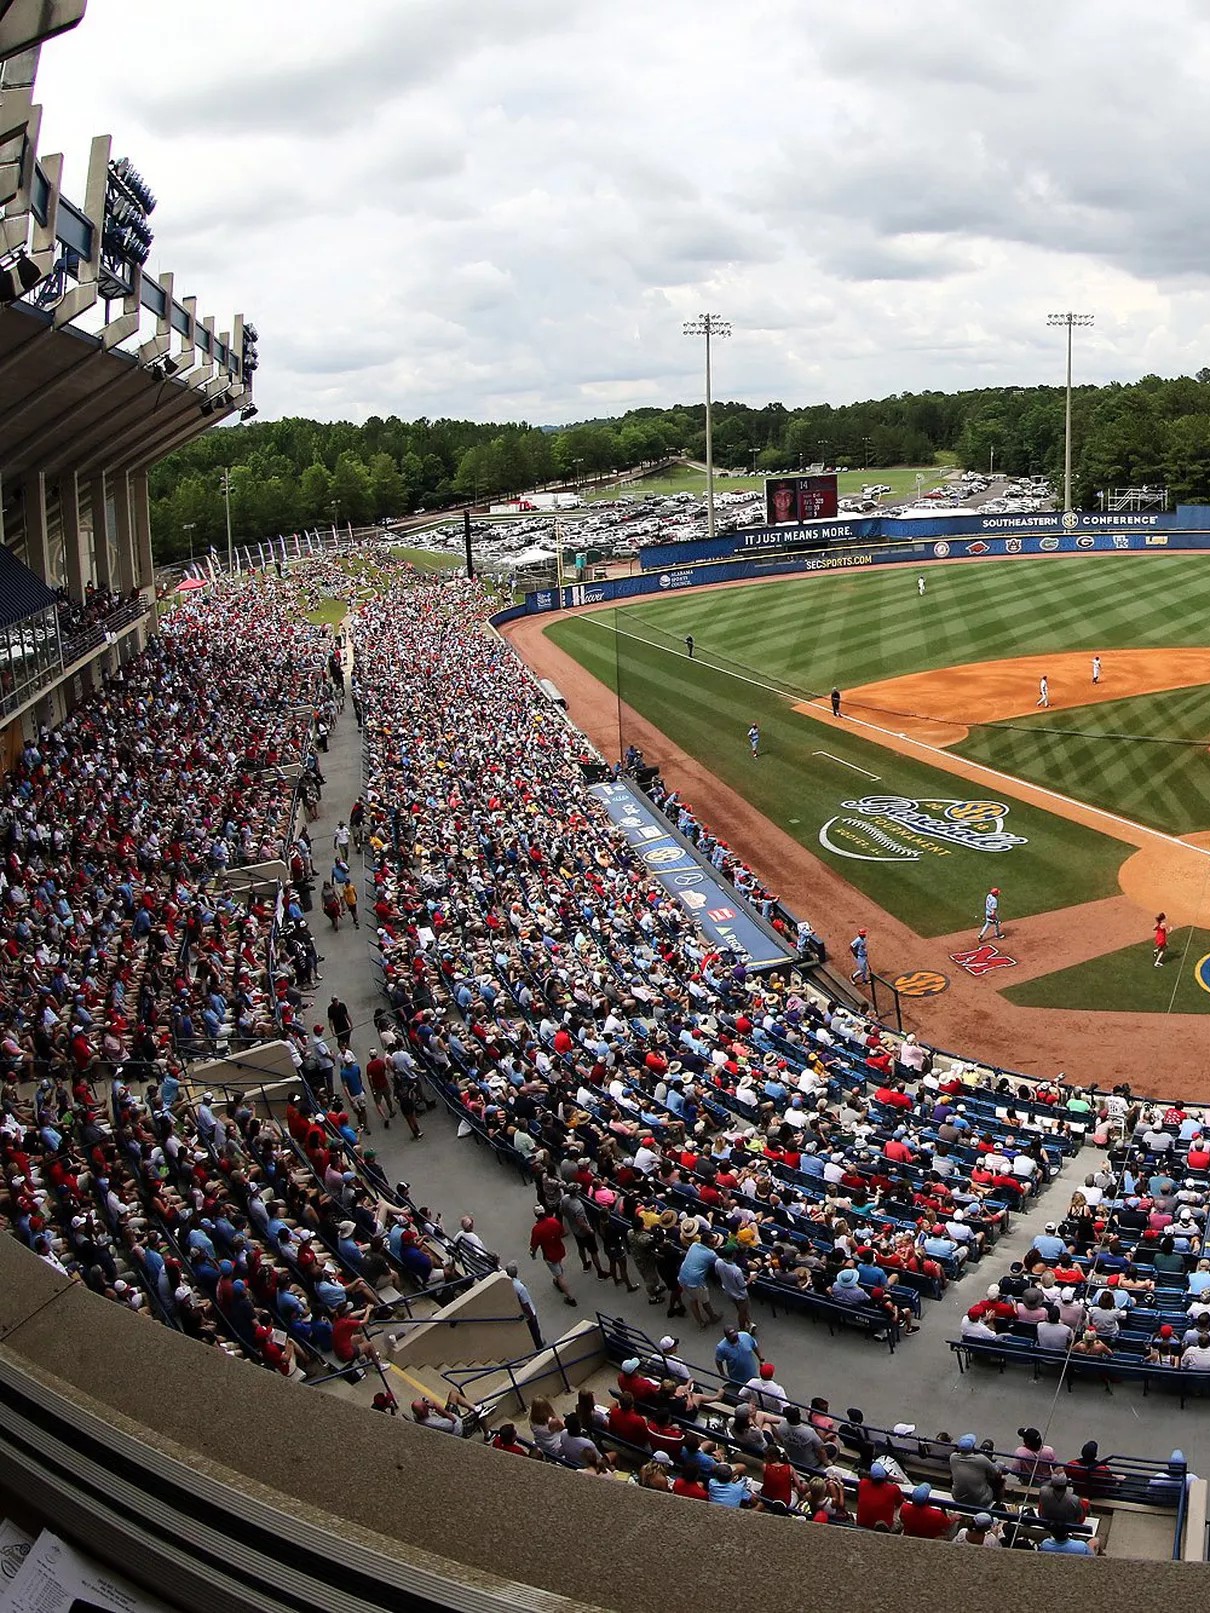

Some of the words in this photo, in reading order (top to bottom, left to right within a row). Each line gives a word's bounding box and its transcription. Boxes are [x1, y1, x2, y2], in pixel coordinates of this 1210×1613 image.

[800, 481, 808, 490] 14
[982, 517, 1058, 528] SOUTHEASTERN
[1082, 515, 1156, 526] CONFERENCE
[745, 535, 755, 545] IT
[755, 532, 782, 544] JUST
[784, 529, 819, 541] MEANS
[822, 526, 853, 538] MORE.
[806, 555, 872, 570] SECSPORTS.COM
[670, 569, 694, 577] ALABAMA
[841, 795, 1029, 852] Baseball
[868, 816, 951, 857] TOURNAMENT
[950, 944, 1017, 976] M
